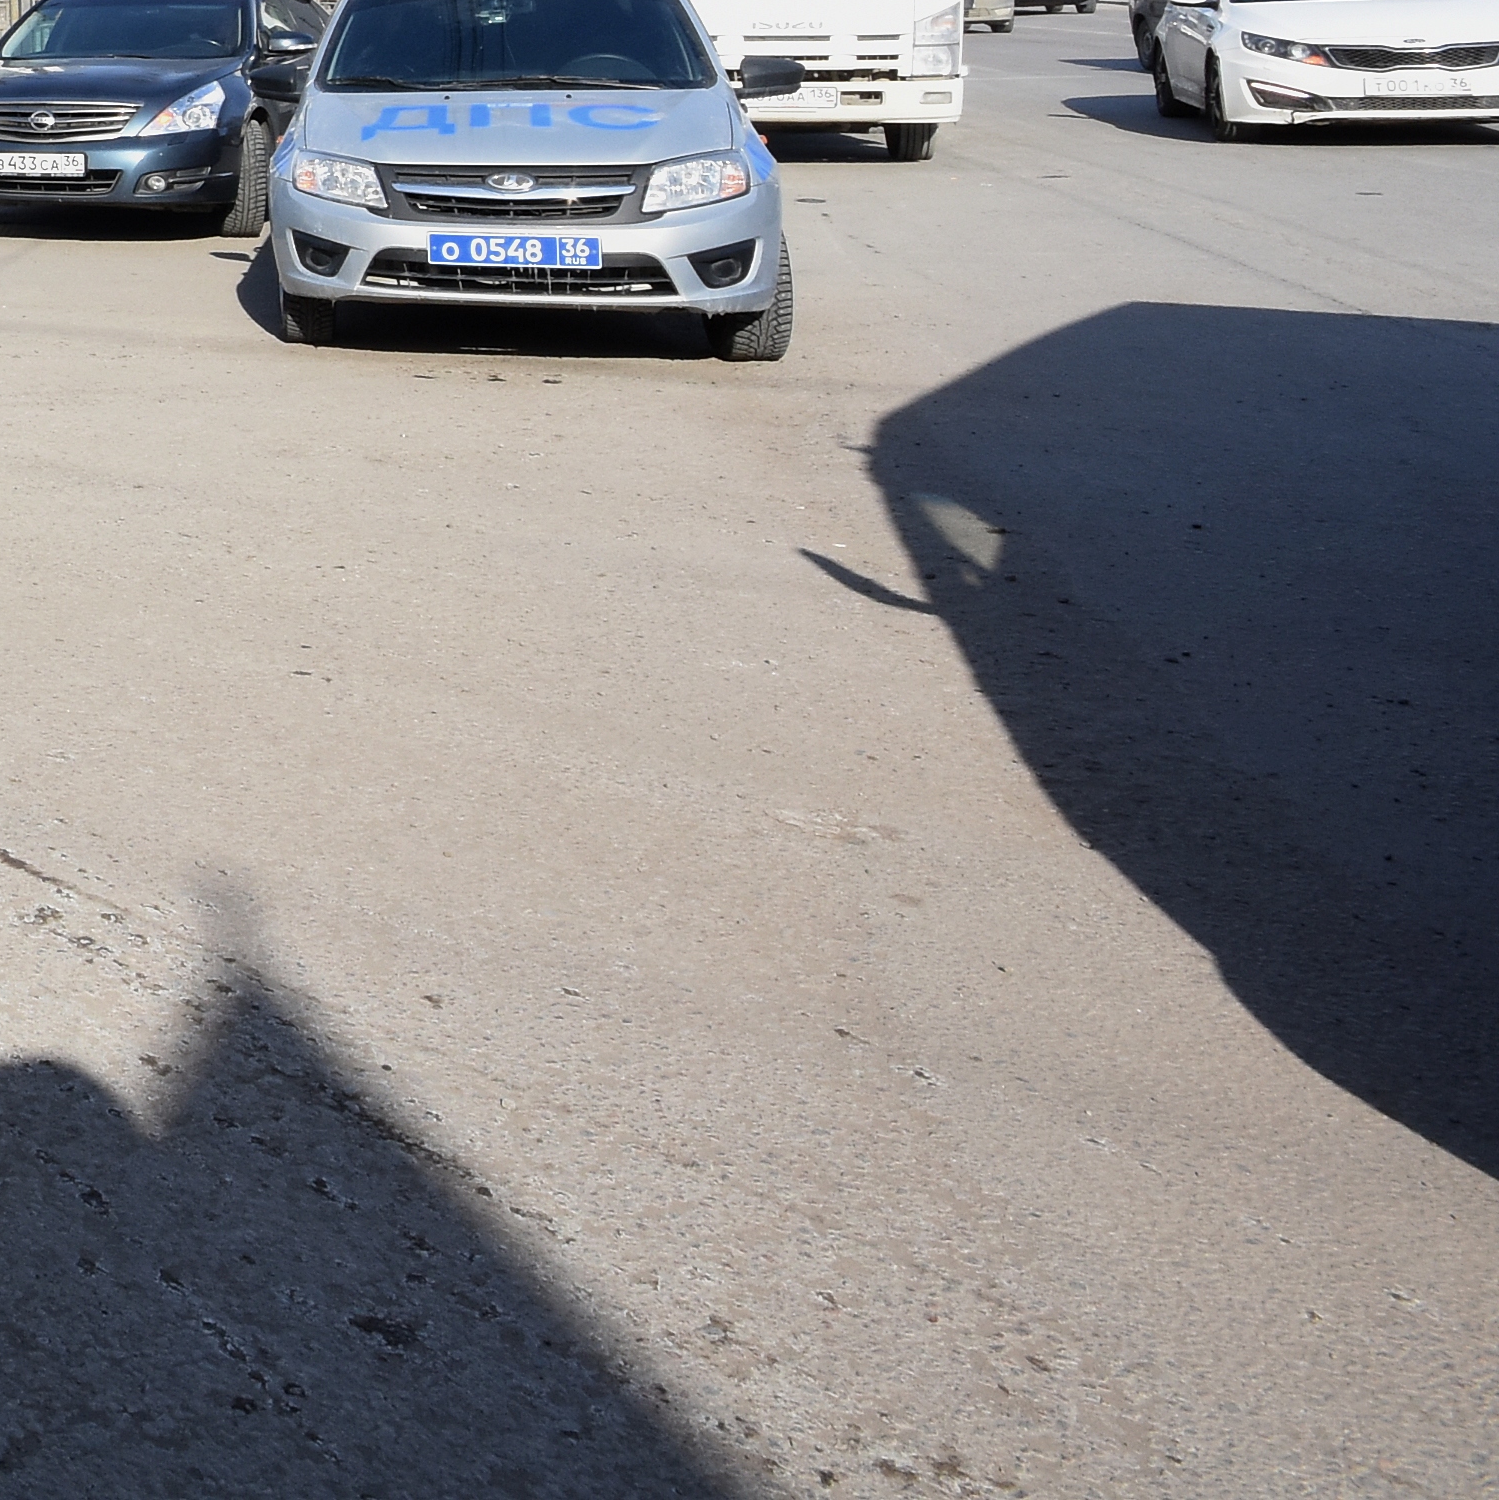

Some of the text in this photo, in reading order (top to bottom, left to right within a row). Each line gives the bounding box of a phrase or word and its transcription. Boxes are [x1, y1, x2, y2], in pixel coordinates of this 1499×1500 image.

[1449, 77, 1467, 88] 36
[809, 89, 832, 99] 136
[361, 103, 661, 142] ДПС
[63, 155, 79, 167] 36
[469, 238, 543, 264] 0548
[561, 238, 590, 258] 36
[564, 257, 588, 266] RUS
